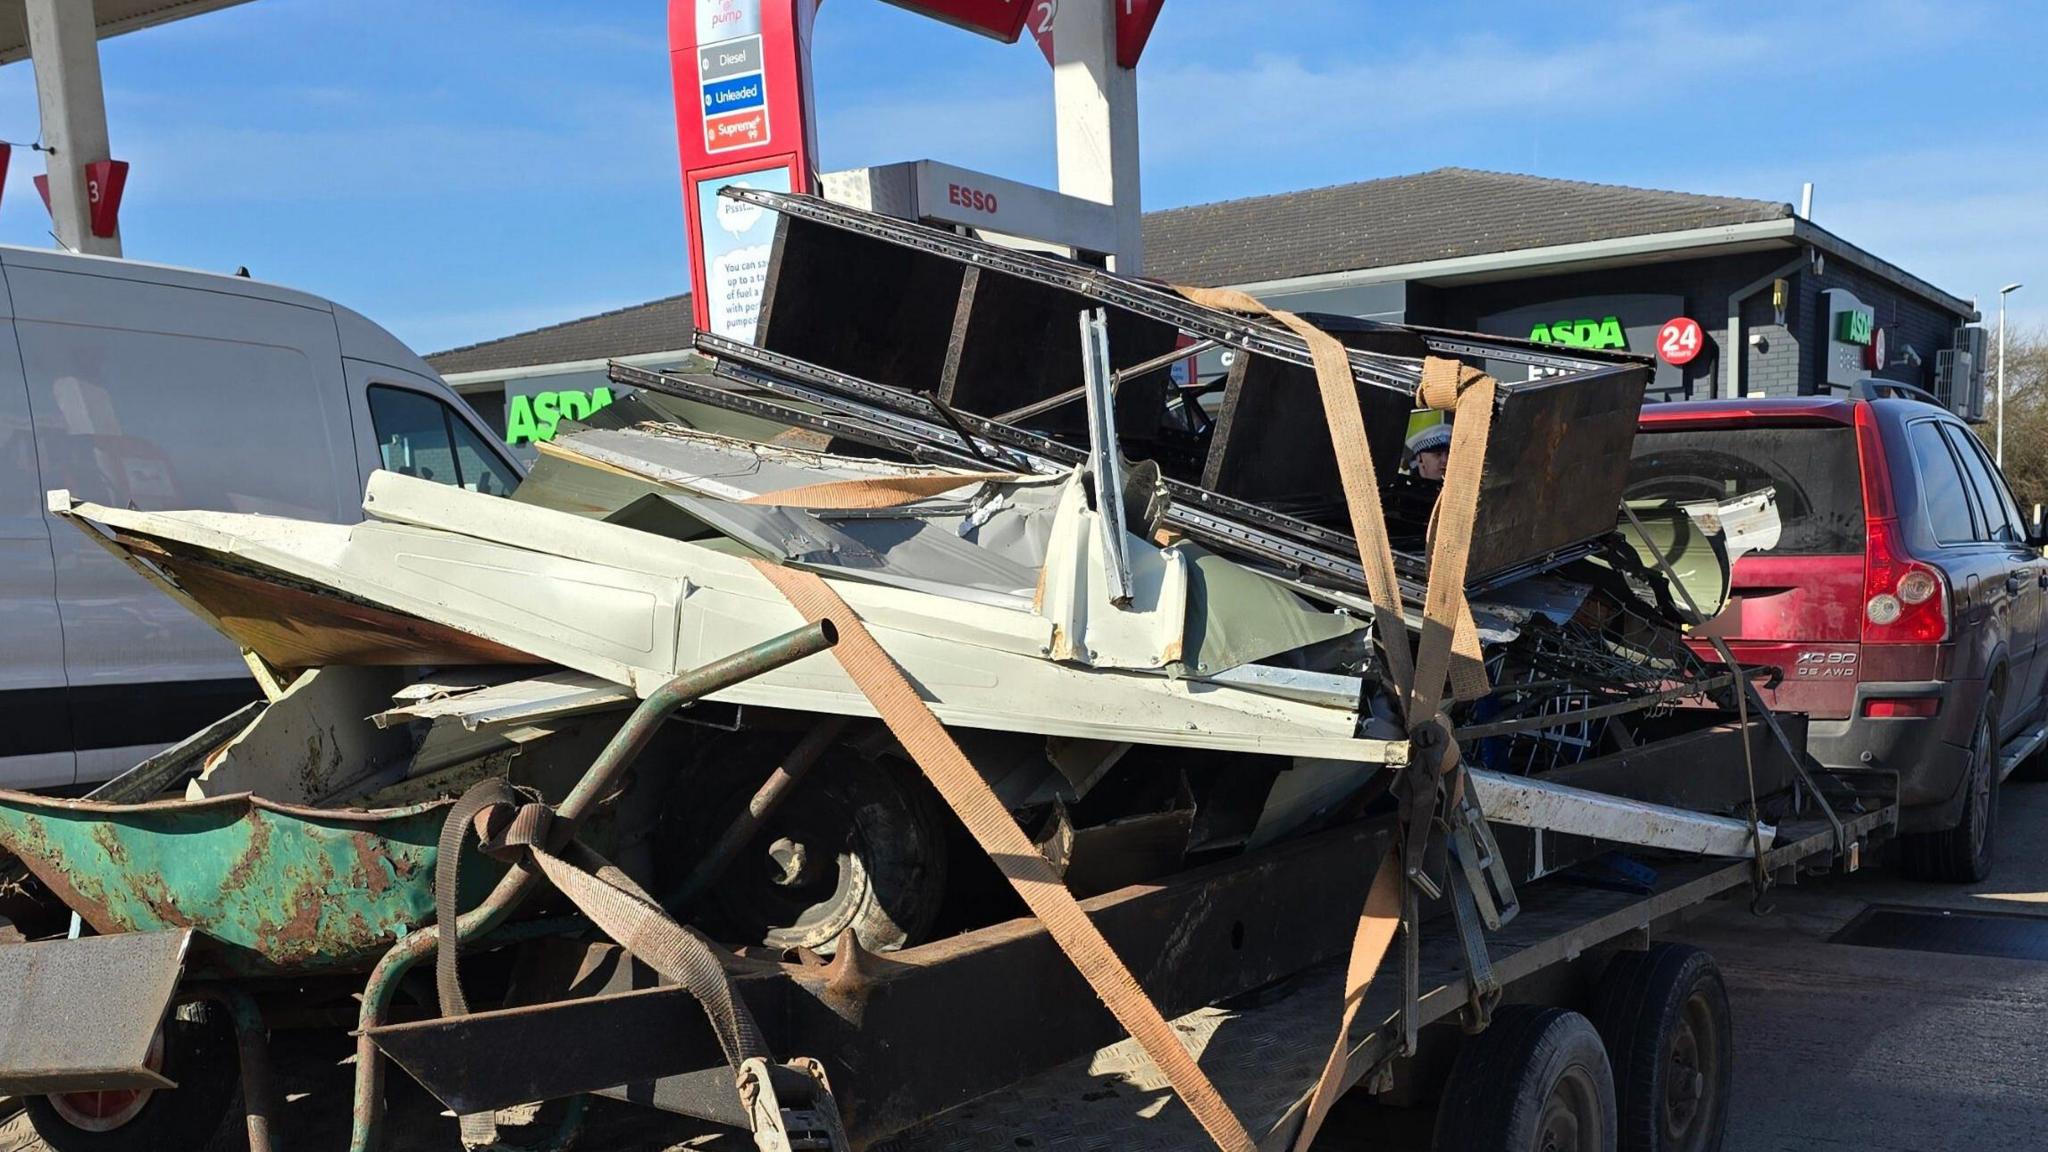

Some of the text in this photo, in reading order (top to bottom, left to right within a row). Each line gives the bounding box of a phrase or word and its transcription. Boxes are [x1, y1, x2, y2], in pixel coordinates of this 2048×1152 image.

[712, 10, 743, 29] pump
[720, 50, 746, 66] Diesel
[715, 83, 757, 103] Unleaded
[89, 180, 99, 203] 3
[949, 183, 997, 214] ESSO
[724, 260, 769, 272] You can sa
[727, 279, 738, 288] up
[739, 276, 748, 284] to
[726, 290, 735, 300] of
[736, 287, 752, 298] fuel
[726, 303, 743, 313] with
[1662, 324, 1697, 352] 24
[1823, 668, 1854, 676] AWD
